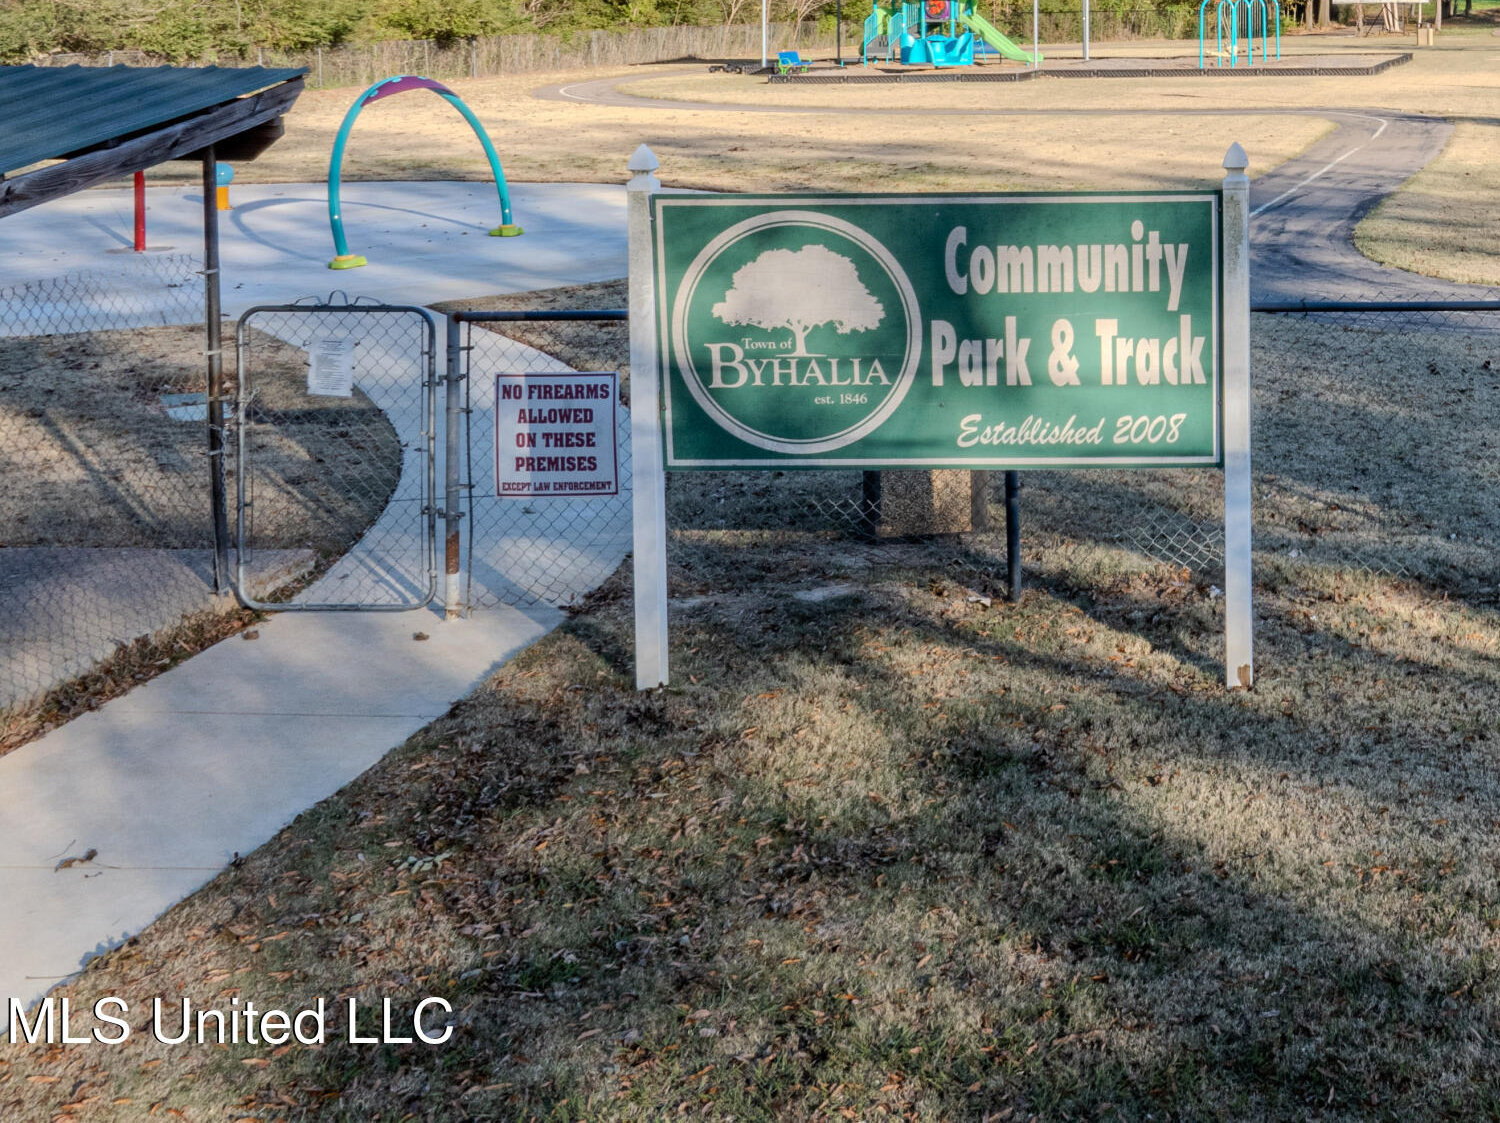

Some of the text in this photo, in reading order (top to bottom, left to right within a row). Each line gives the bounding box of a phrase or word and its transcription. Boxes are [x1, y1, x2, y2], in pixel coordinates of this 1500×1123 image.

[944, 219, 1189, 311] Community
[741, 337, 793, 350] Town of
[931, 314, 1207, 387] Park & Track
[704, 342, 892, 389] BYHALIA
[502, 384, 609, 400] NO FIREARMS
[814, 393, 868, 405] est. 1846
[517, 408, 594, 424] ALLOWED
[956, 413, 1187, 448] Established 2008
[515, 432, 596, 448] ON THESE
[515, 456, 597, 472] PREMISES
[502, 481, 612, 491] EXCEPT LAW ENFORCEMENT
